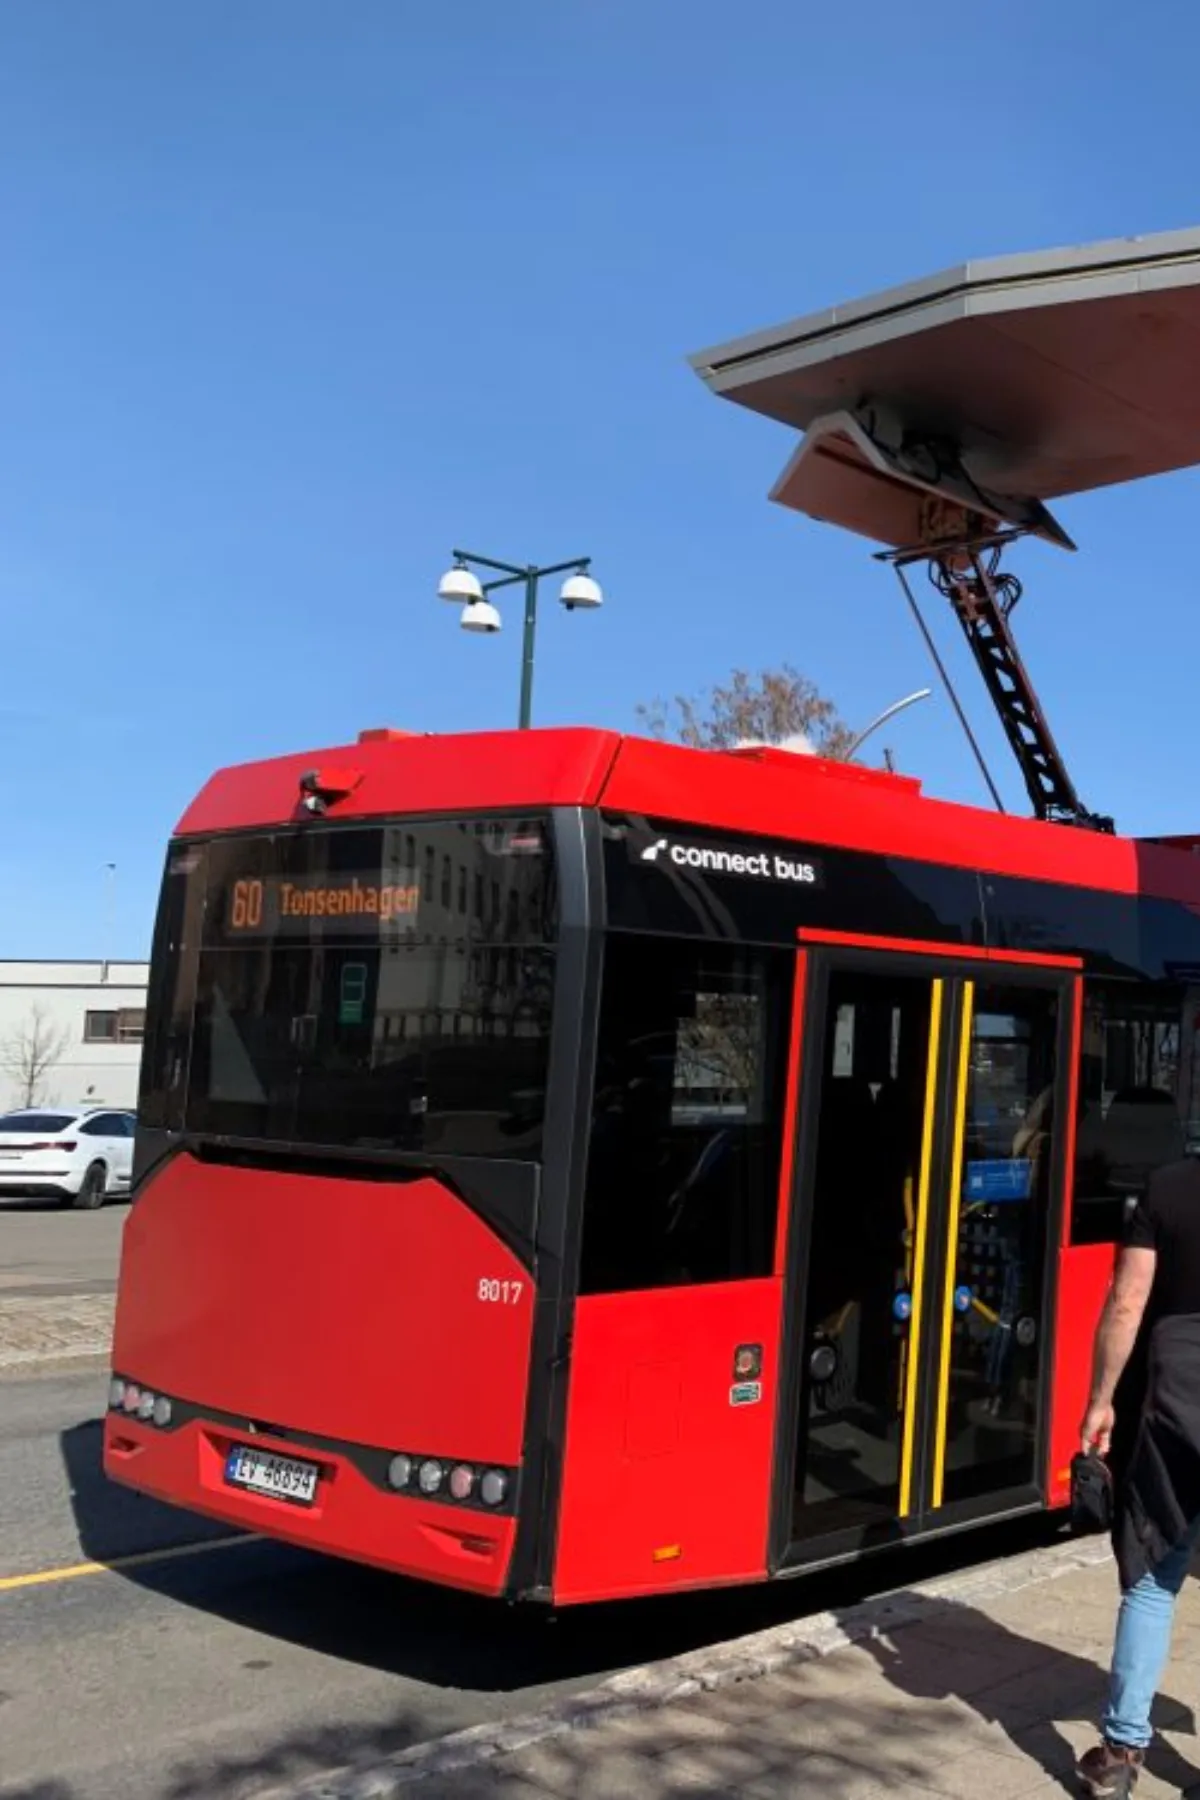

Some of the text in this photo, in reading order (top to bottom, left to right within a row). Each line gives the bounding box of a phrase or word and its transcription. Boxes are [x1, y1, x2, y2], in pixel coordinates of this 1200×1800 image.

[671, 845, 815, 882] connect bus
[232, 877, 419, 927] 60 Tonsenhagen
[478, 1278, 523, 1304] 8017
